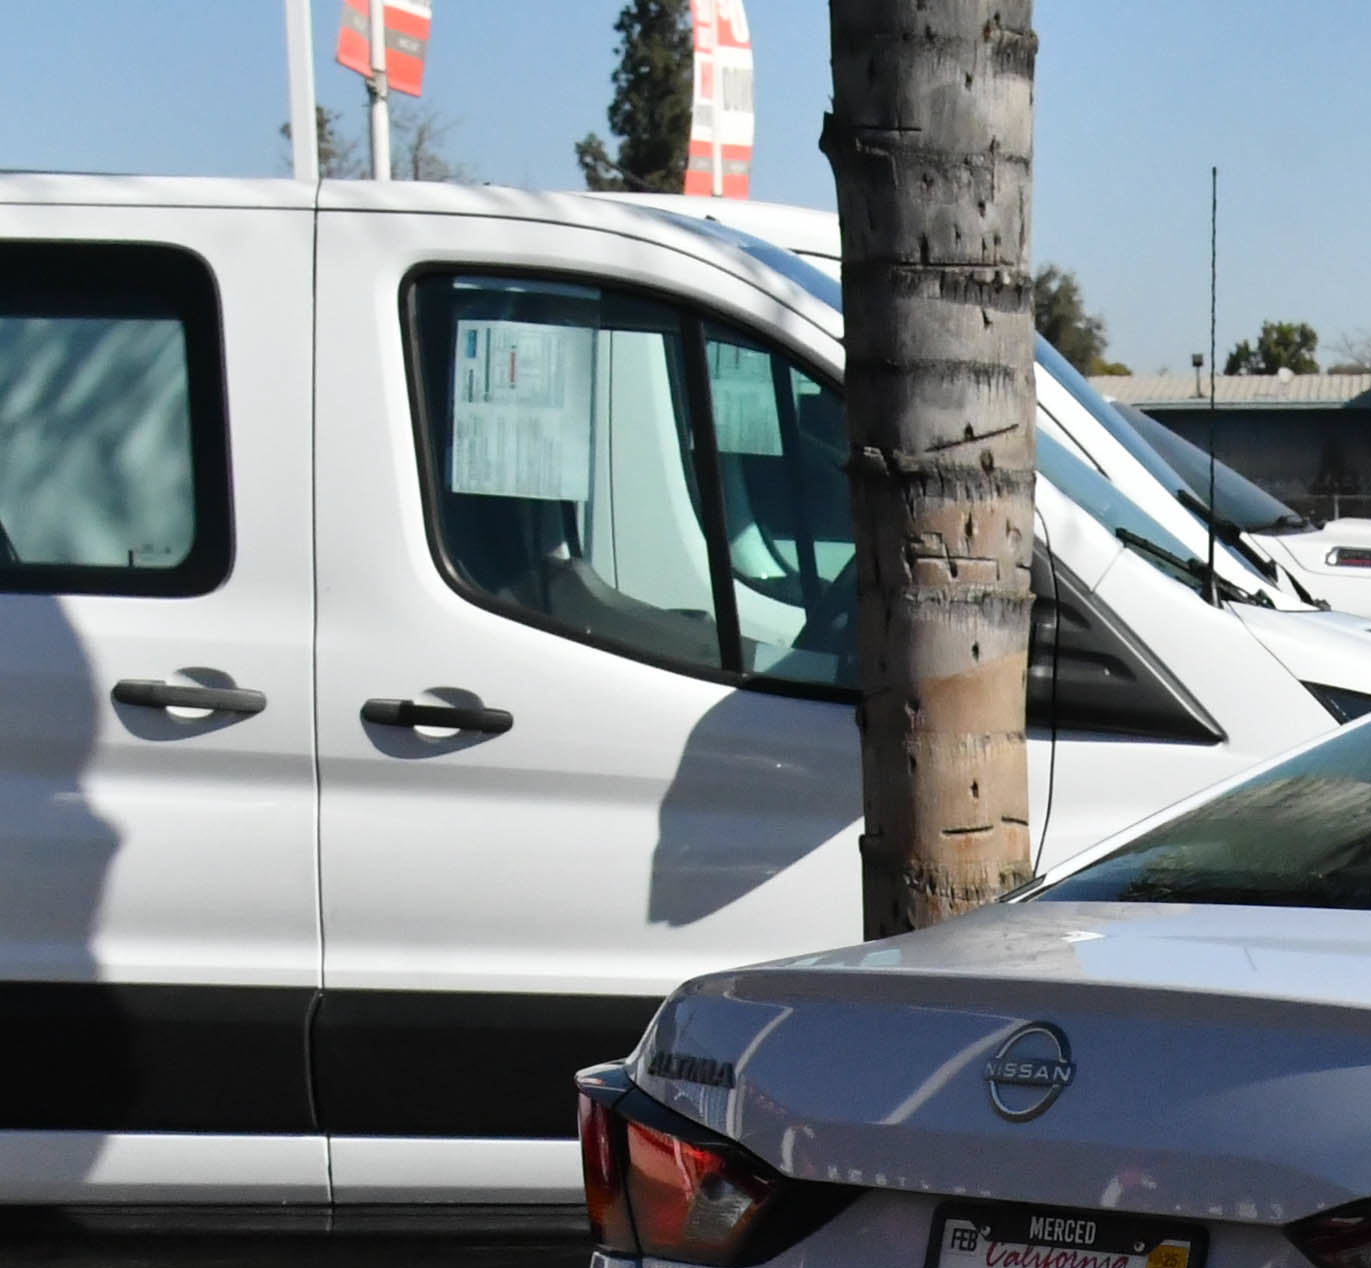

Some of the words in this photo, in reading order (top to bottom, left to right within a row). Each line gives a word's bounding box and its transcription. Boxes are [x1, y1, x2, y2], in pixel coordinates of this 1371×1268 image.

[985, 1061, 1071, 1081] NISSAN
[951, 1228, 978, 1251] FEB
[1029, 1215, 1097, 1245] MERCED
